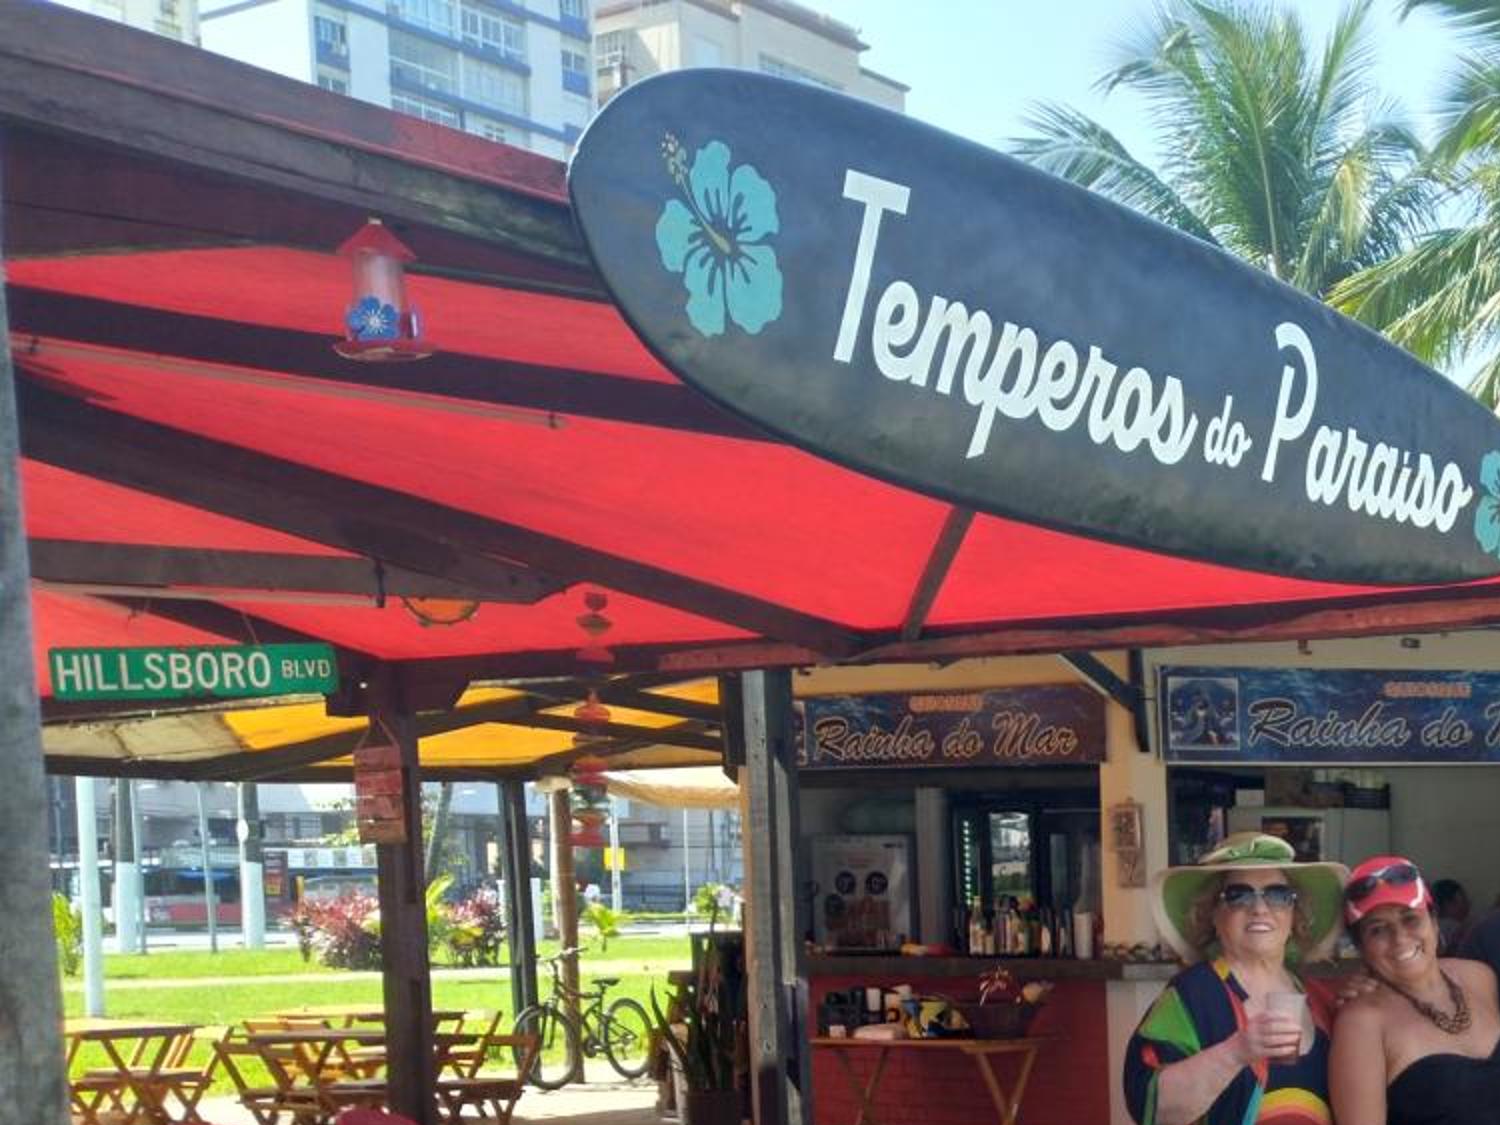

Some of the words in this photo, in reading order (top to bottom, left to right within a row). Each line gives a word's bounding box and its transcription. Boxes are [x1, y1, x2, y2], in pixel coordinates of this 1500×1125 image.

[834, 169, 1198, 464] Temperos
[1204, 395, 1252, 468] do
[1261, 322, 1473, 532] Paraiso
[55, 651, 271, 691] HILLSBORO
[281, 659, 330, 679] BLVD
[814, 714, 936, 761] Rainha
[942, 717, 984, 758] do
[991, 710, 1079, 759] Mar
[1246, 697, 1411, 749] Rainha
[1420, 707, 1474, 748] do
